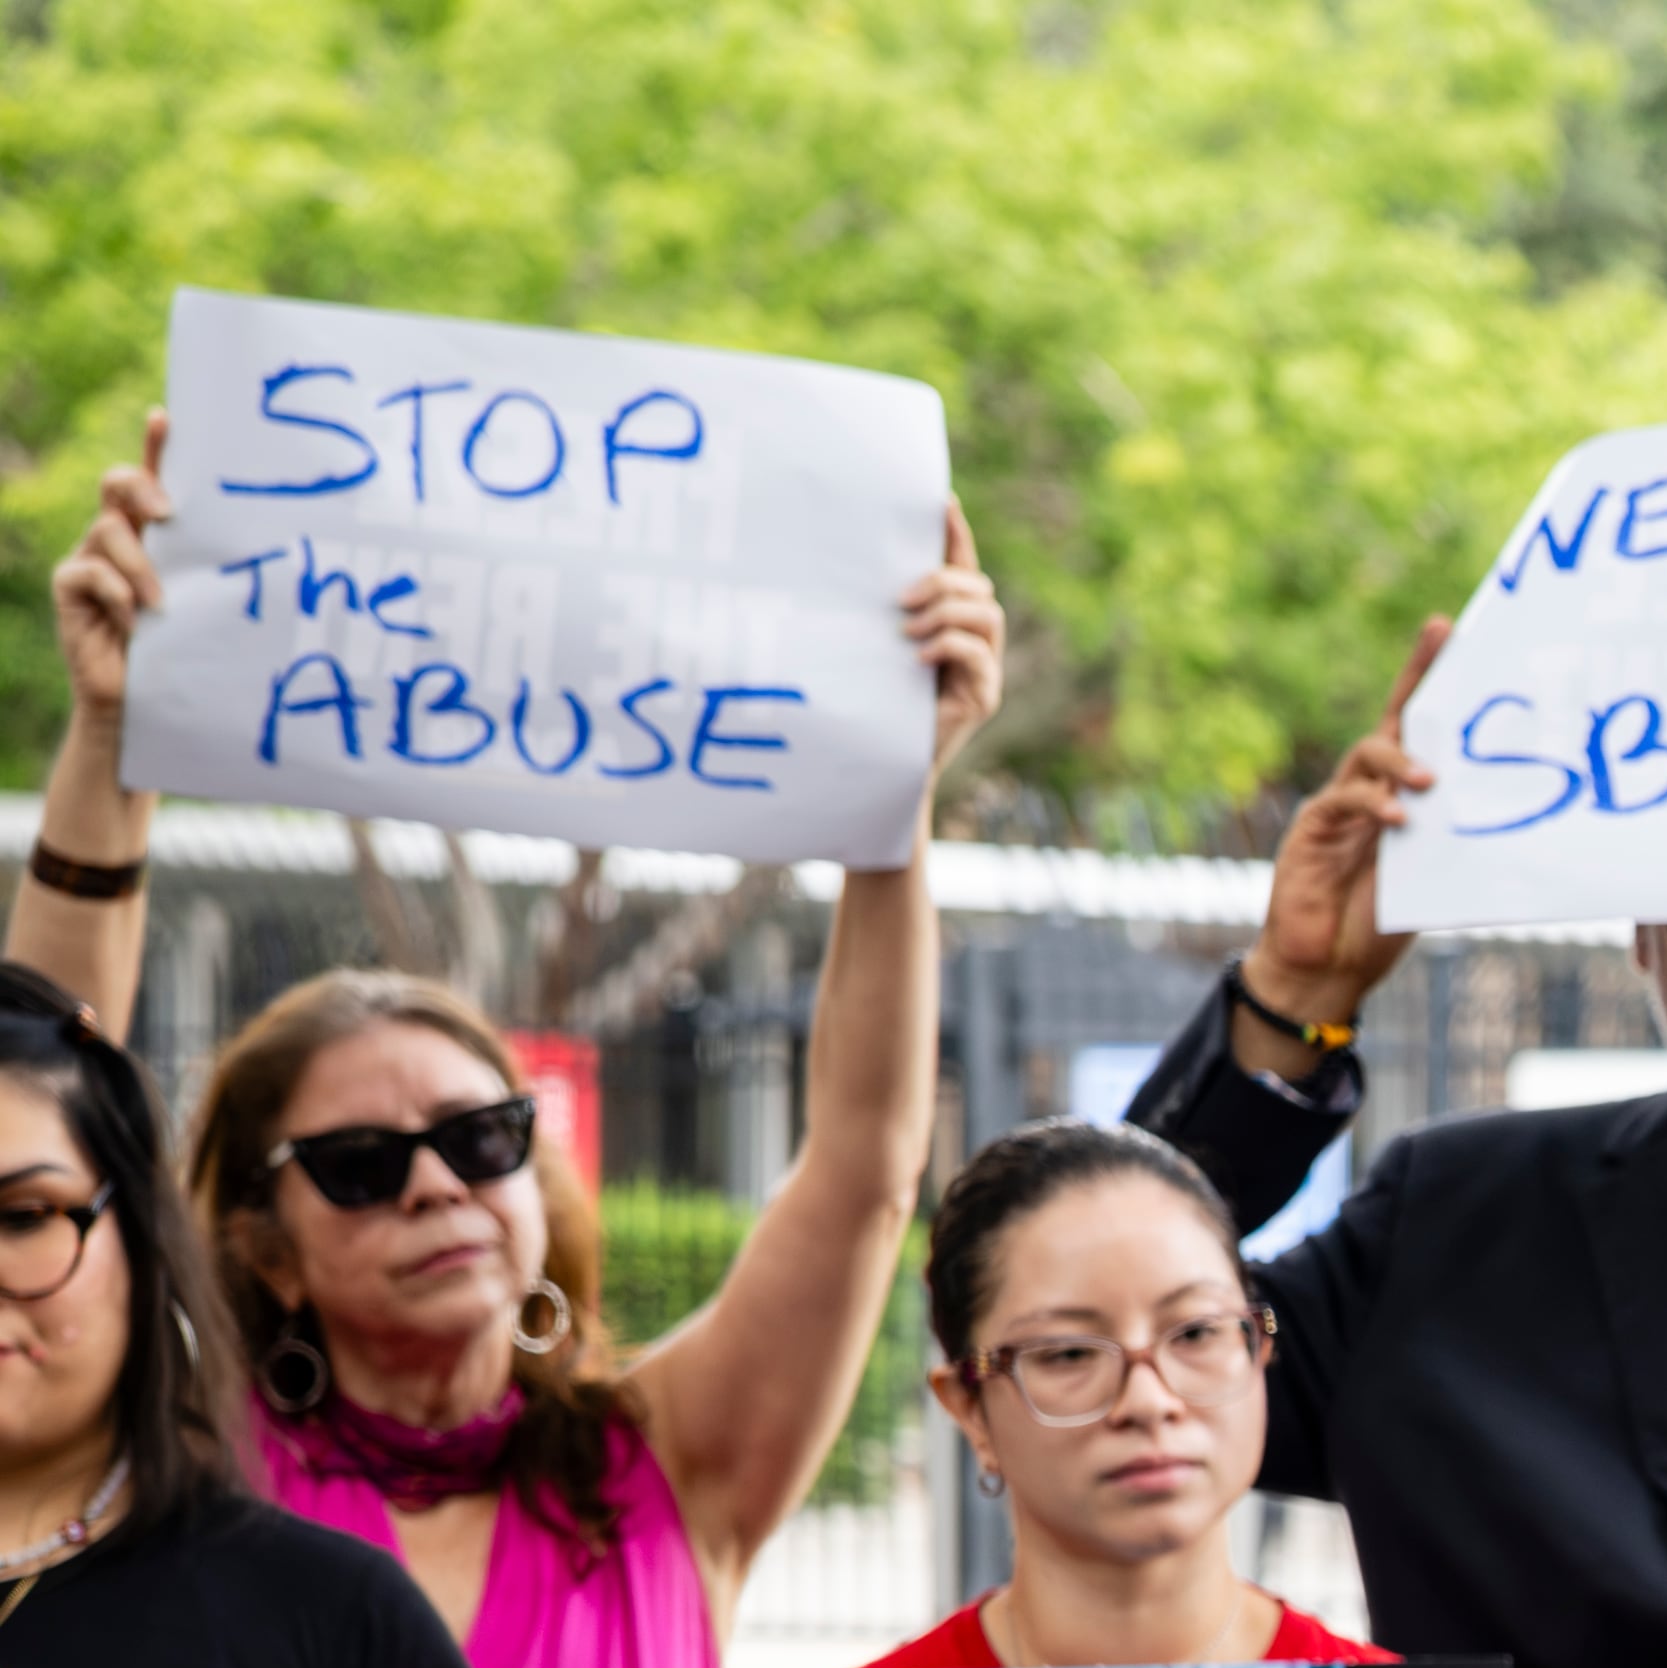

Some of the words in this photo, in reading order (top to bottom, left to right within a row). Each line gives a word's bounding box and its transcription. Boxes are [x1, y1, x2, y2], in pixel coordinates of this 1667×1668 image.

[219, 363, 706, 505] STOP
[220, 537, 434, 640] The
[256, 652, 808, 791] ABUSE
